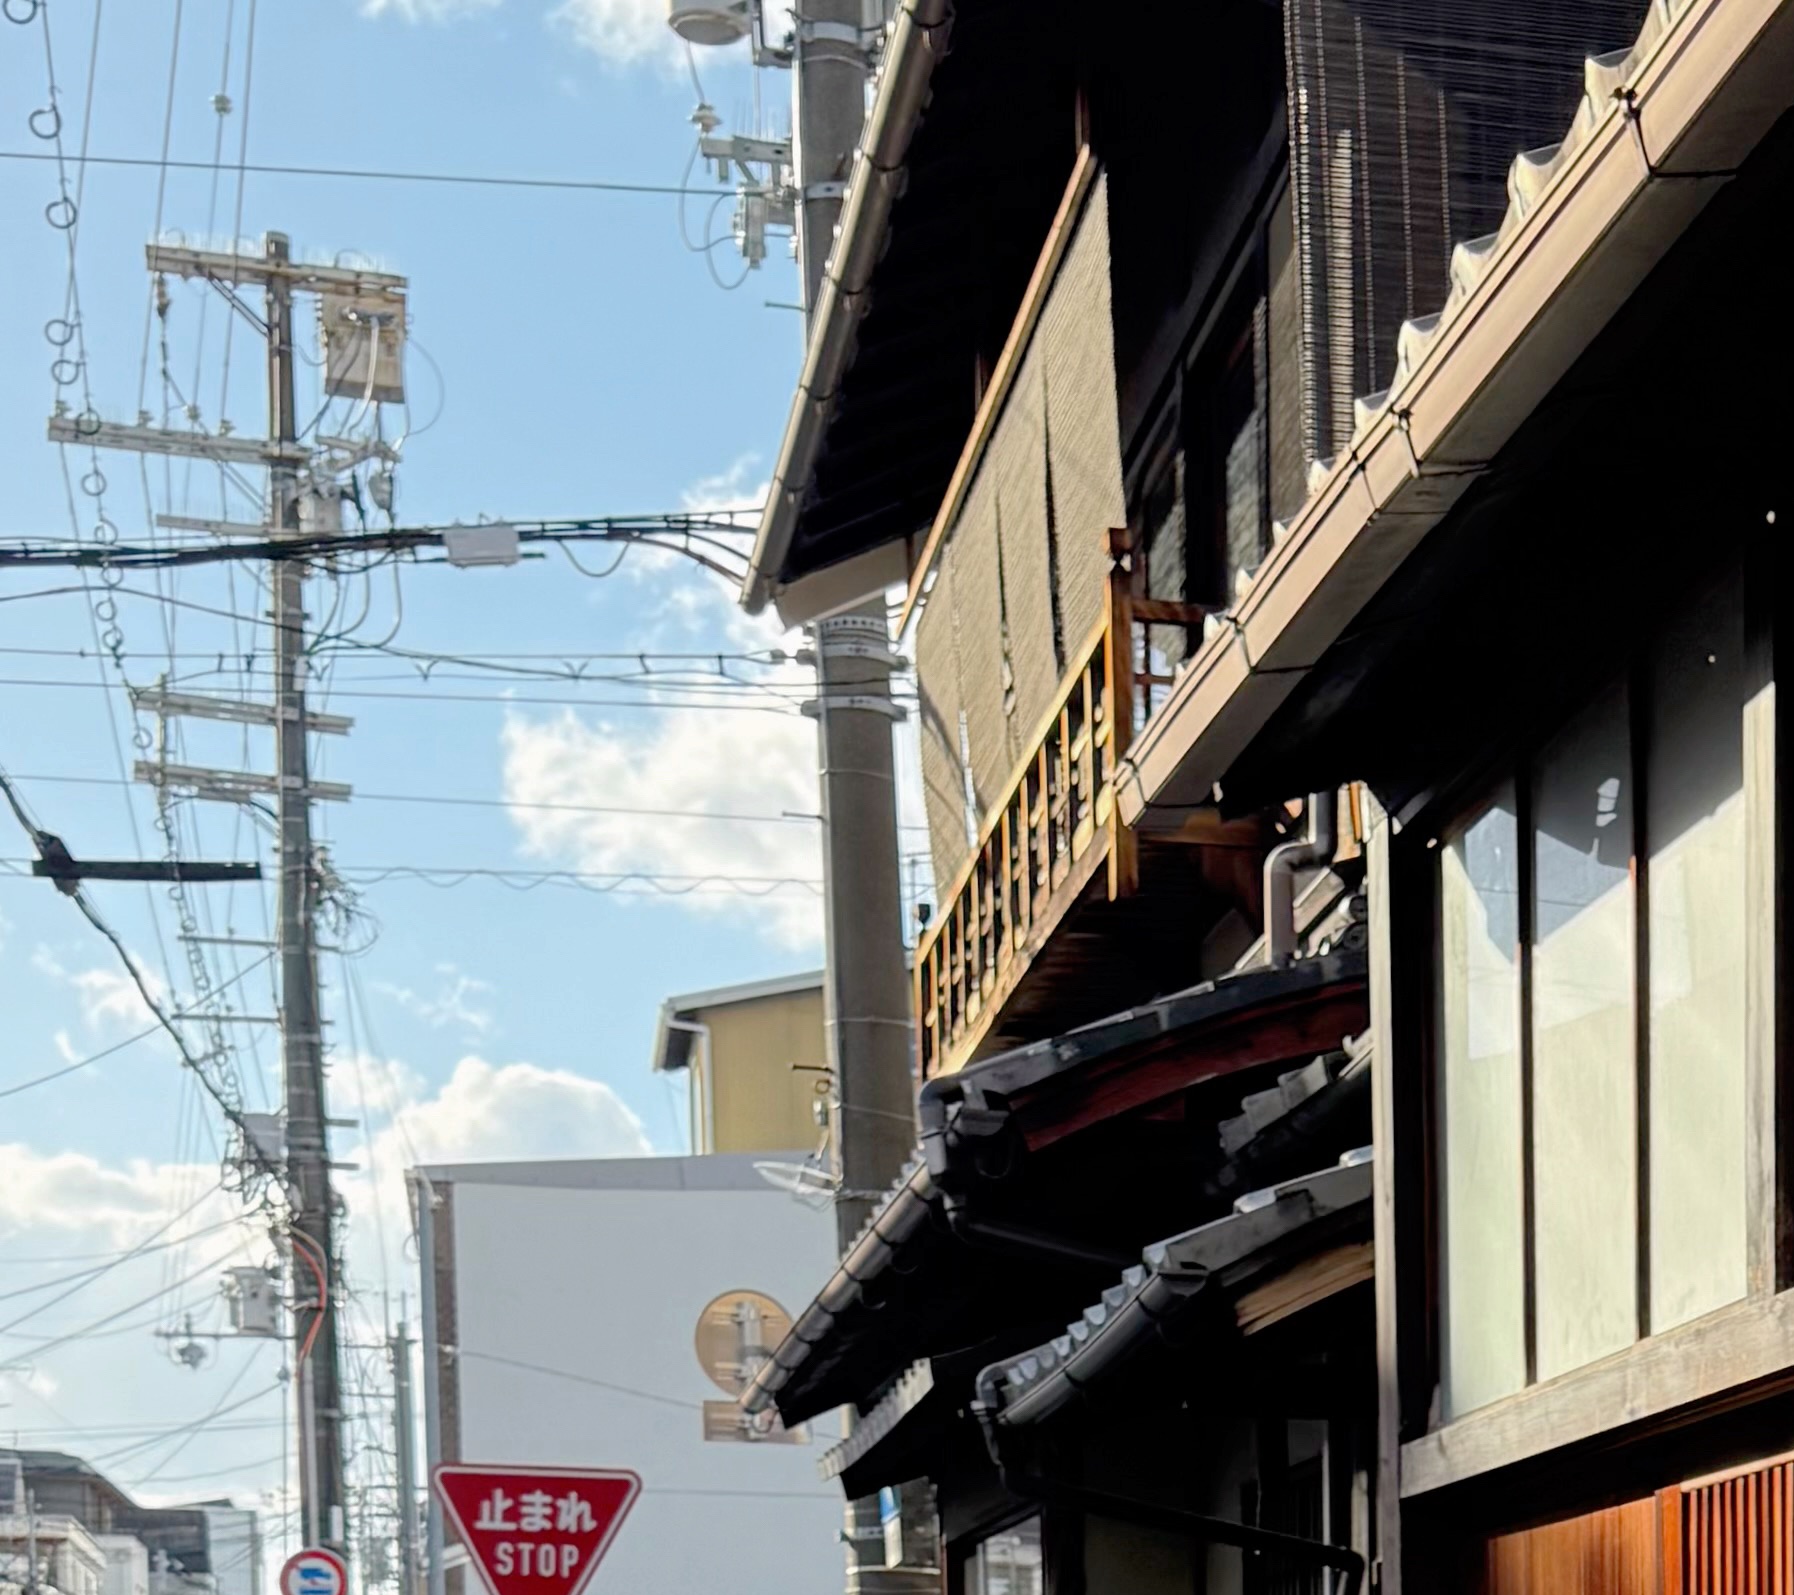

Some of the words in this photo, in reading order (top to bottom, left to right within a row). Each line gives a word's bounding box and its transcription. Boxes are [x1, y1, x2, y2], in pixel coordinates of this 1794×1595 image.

[473, 1487, 598, 1534] 止まれ
[495, 1542, 579, 1578] STOP
